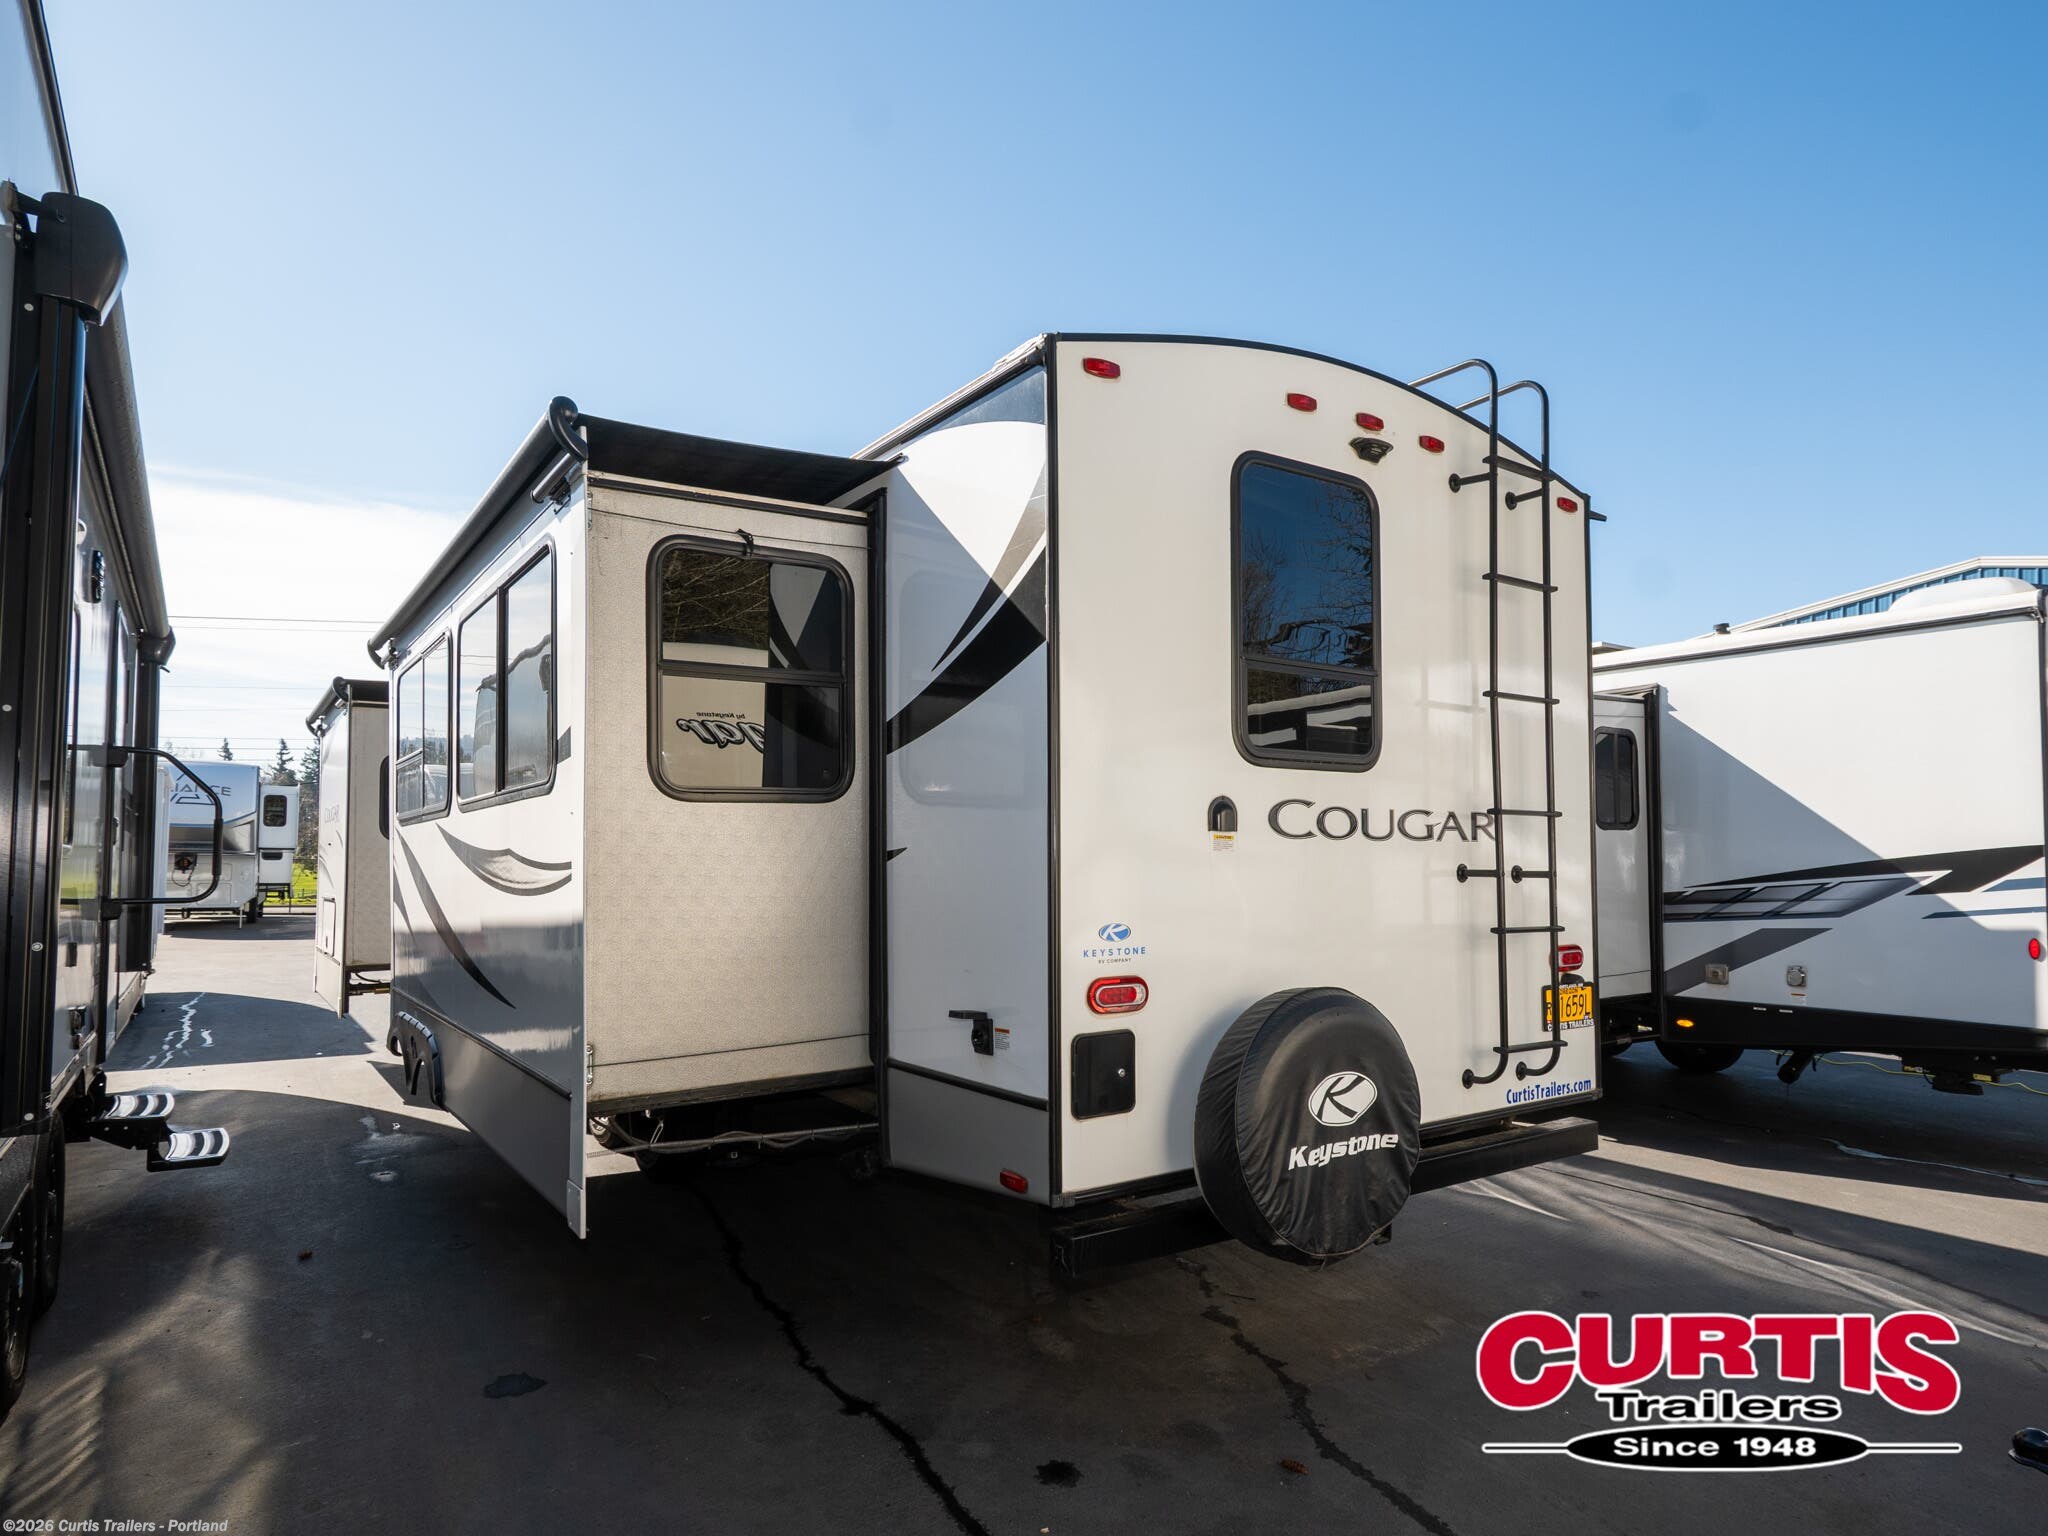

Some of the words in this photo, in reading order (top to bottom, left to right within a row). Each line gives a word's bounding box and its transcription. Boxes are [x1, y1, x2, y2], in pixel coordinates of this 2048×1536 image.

[1083, 946, 1146, 958] KEYSTONE
[1506, 1080, 1592, 1104] CurtisTrailers.com
[1288, 1133, 1399, 1171] Keystone
